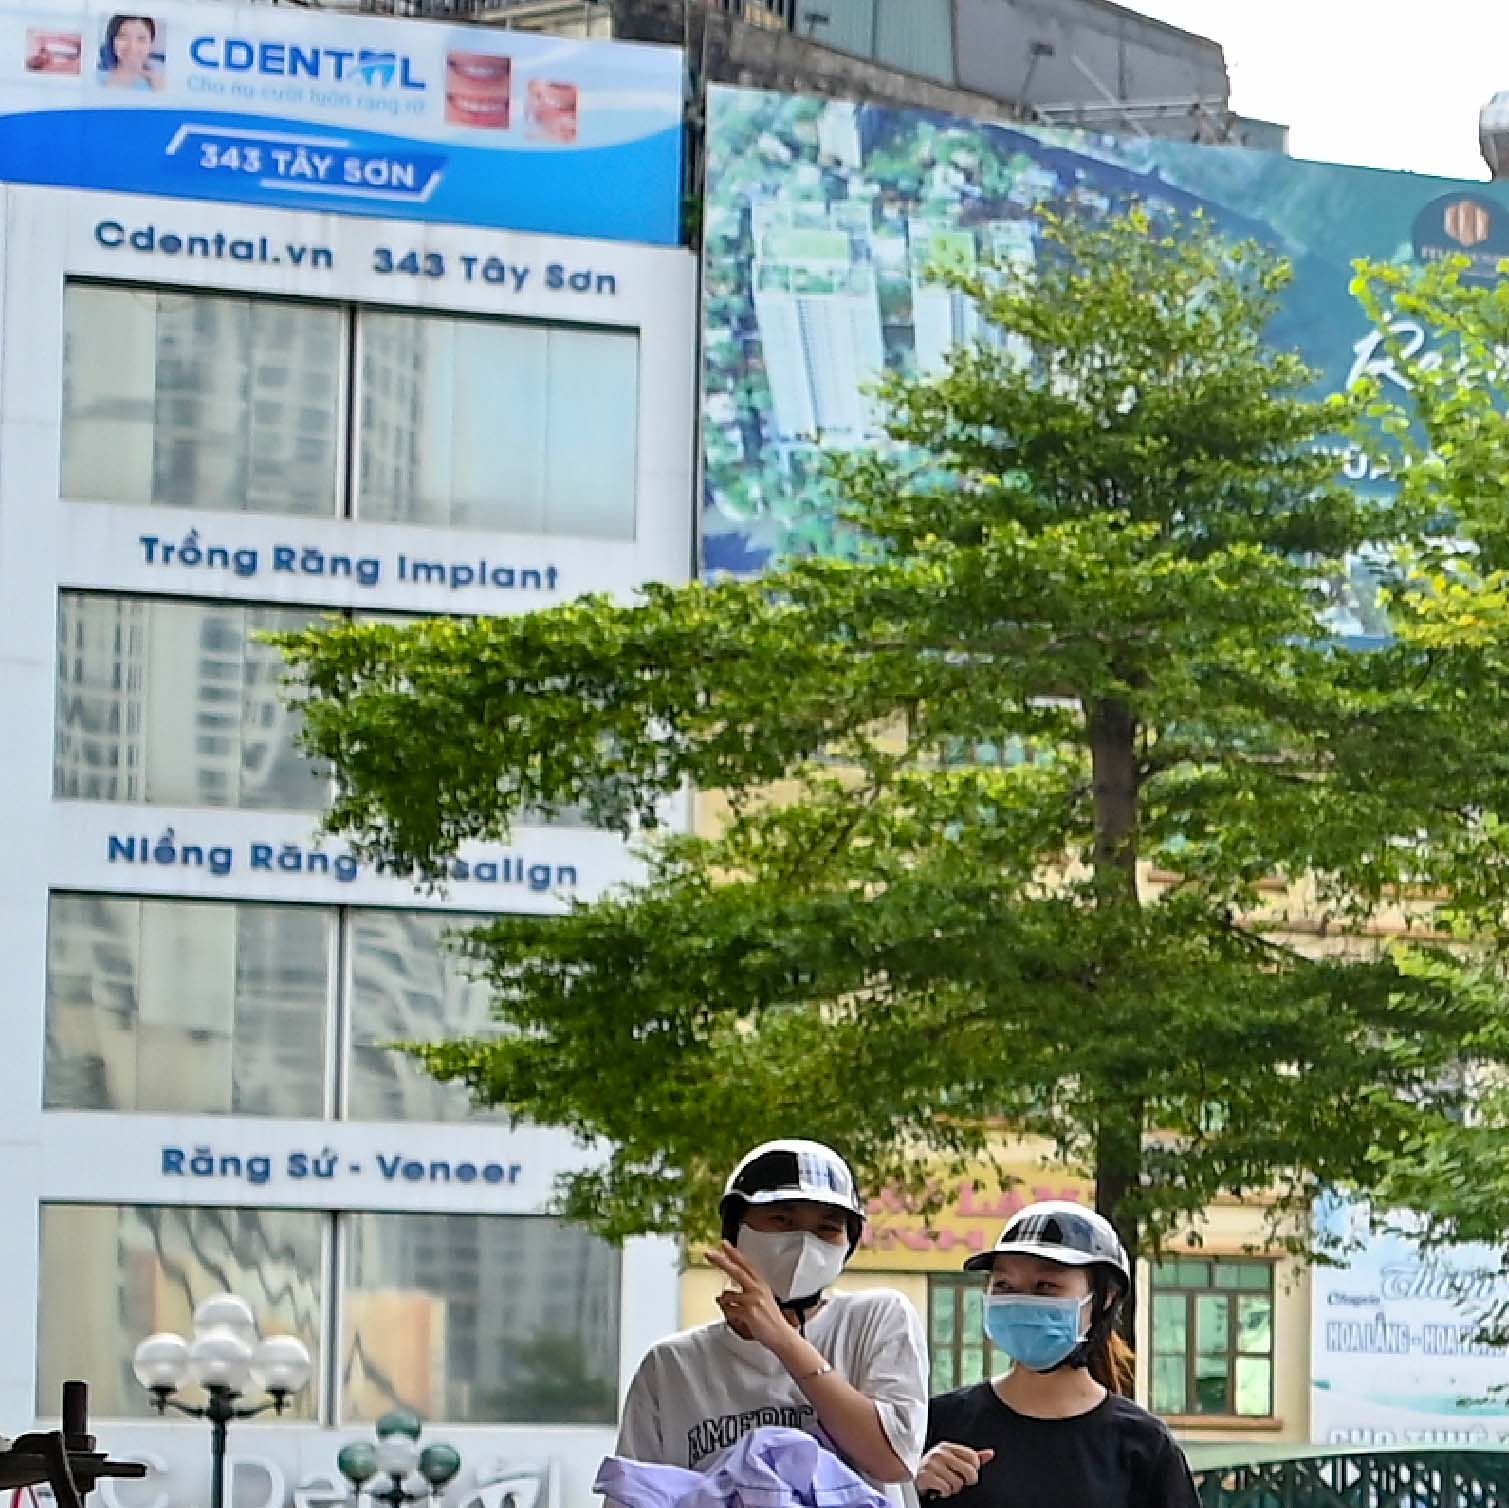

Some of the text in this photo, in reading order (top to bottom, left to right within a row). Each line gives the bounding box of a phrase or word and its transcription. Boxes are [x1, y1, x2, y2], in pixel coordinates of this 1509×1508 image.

[200, 143, 415, 188] 343 TÂY SƠN
[95, 221, 616, 296] Cdental.vn 343 Tây Sơn
[138, 528, 559, 590] Trồng Răng Implant
[250, 844, 358, 883] Răng
[161, 1145, 271, 1185] Răng
[286, 1144, 338, 1179] Sứ
[376, 1153, 522, 1185] Veneer
